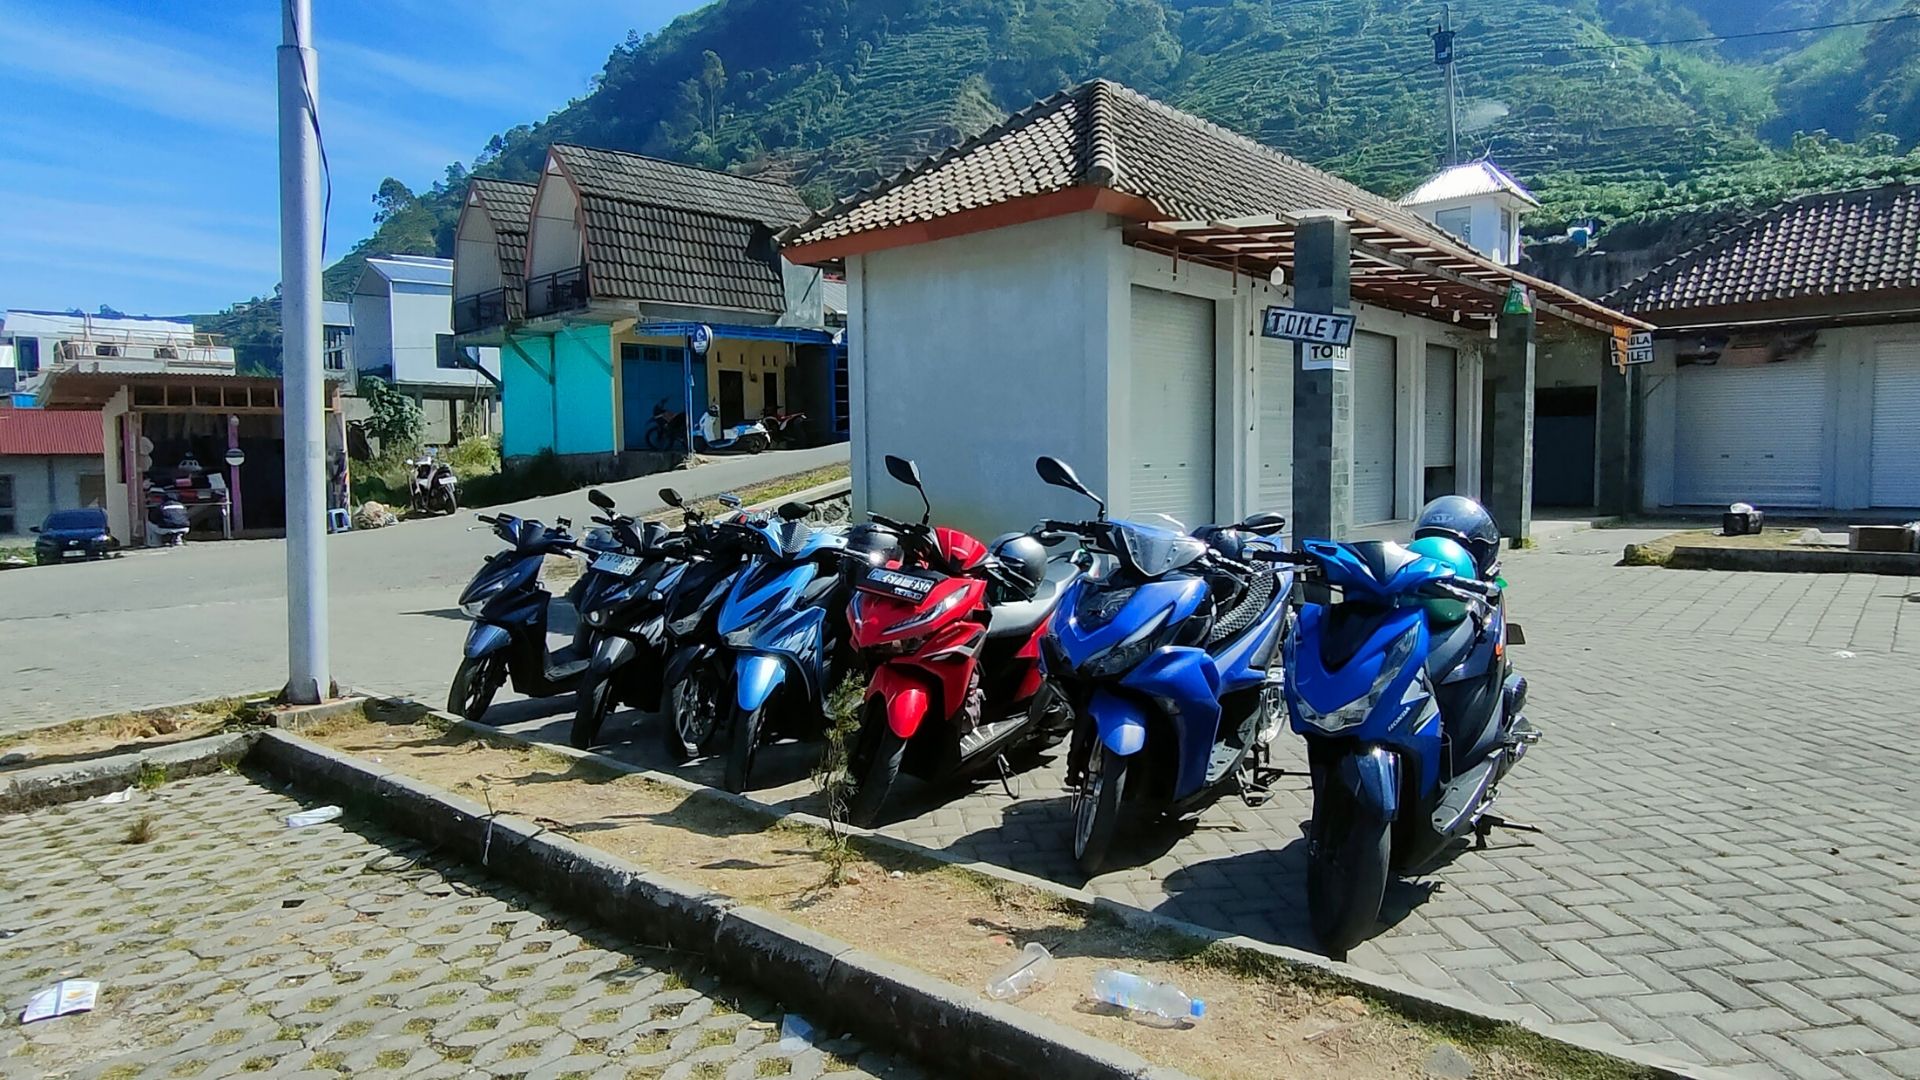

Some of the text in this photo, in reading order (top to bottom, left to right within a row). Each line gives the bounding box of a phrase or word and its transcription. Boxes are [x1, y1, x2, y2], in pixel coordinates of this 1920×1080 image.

[1271, 313, 1348, 339] TOILET
[1612, 350, 1651, 363] TILET
[1387, 706, 1411, 732] HONDA
